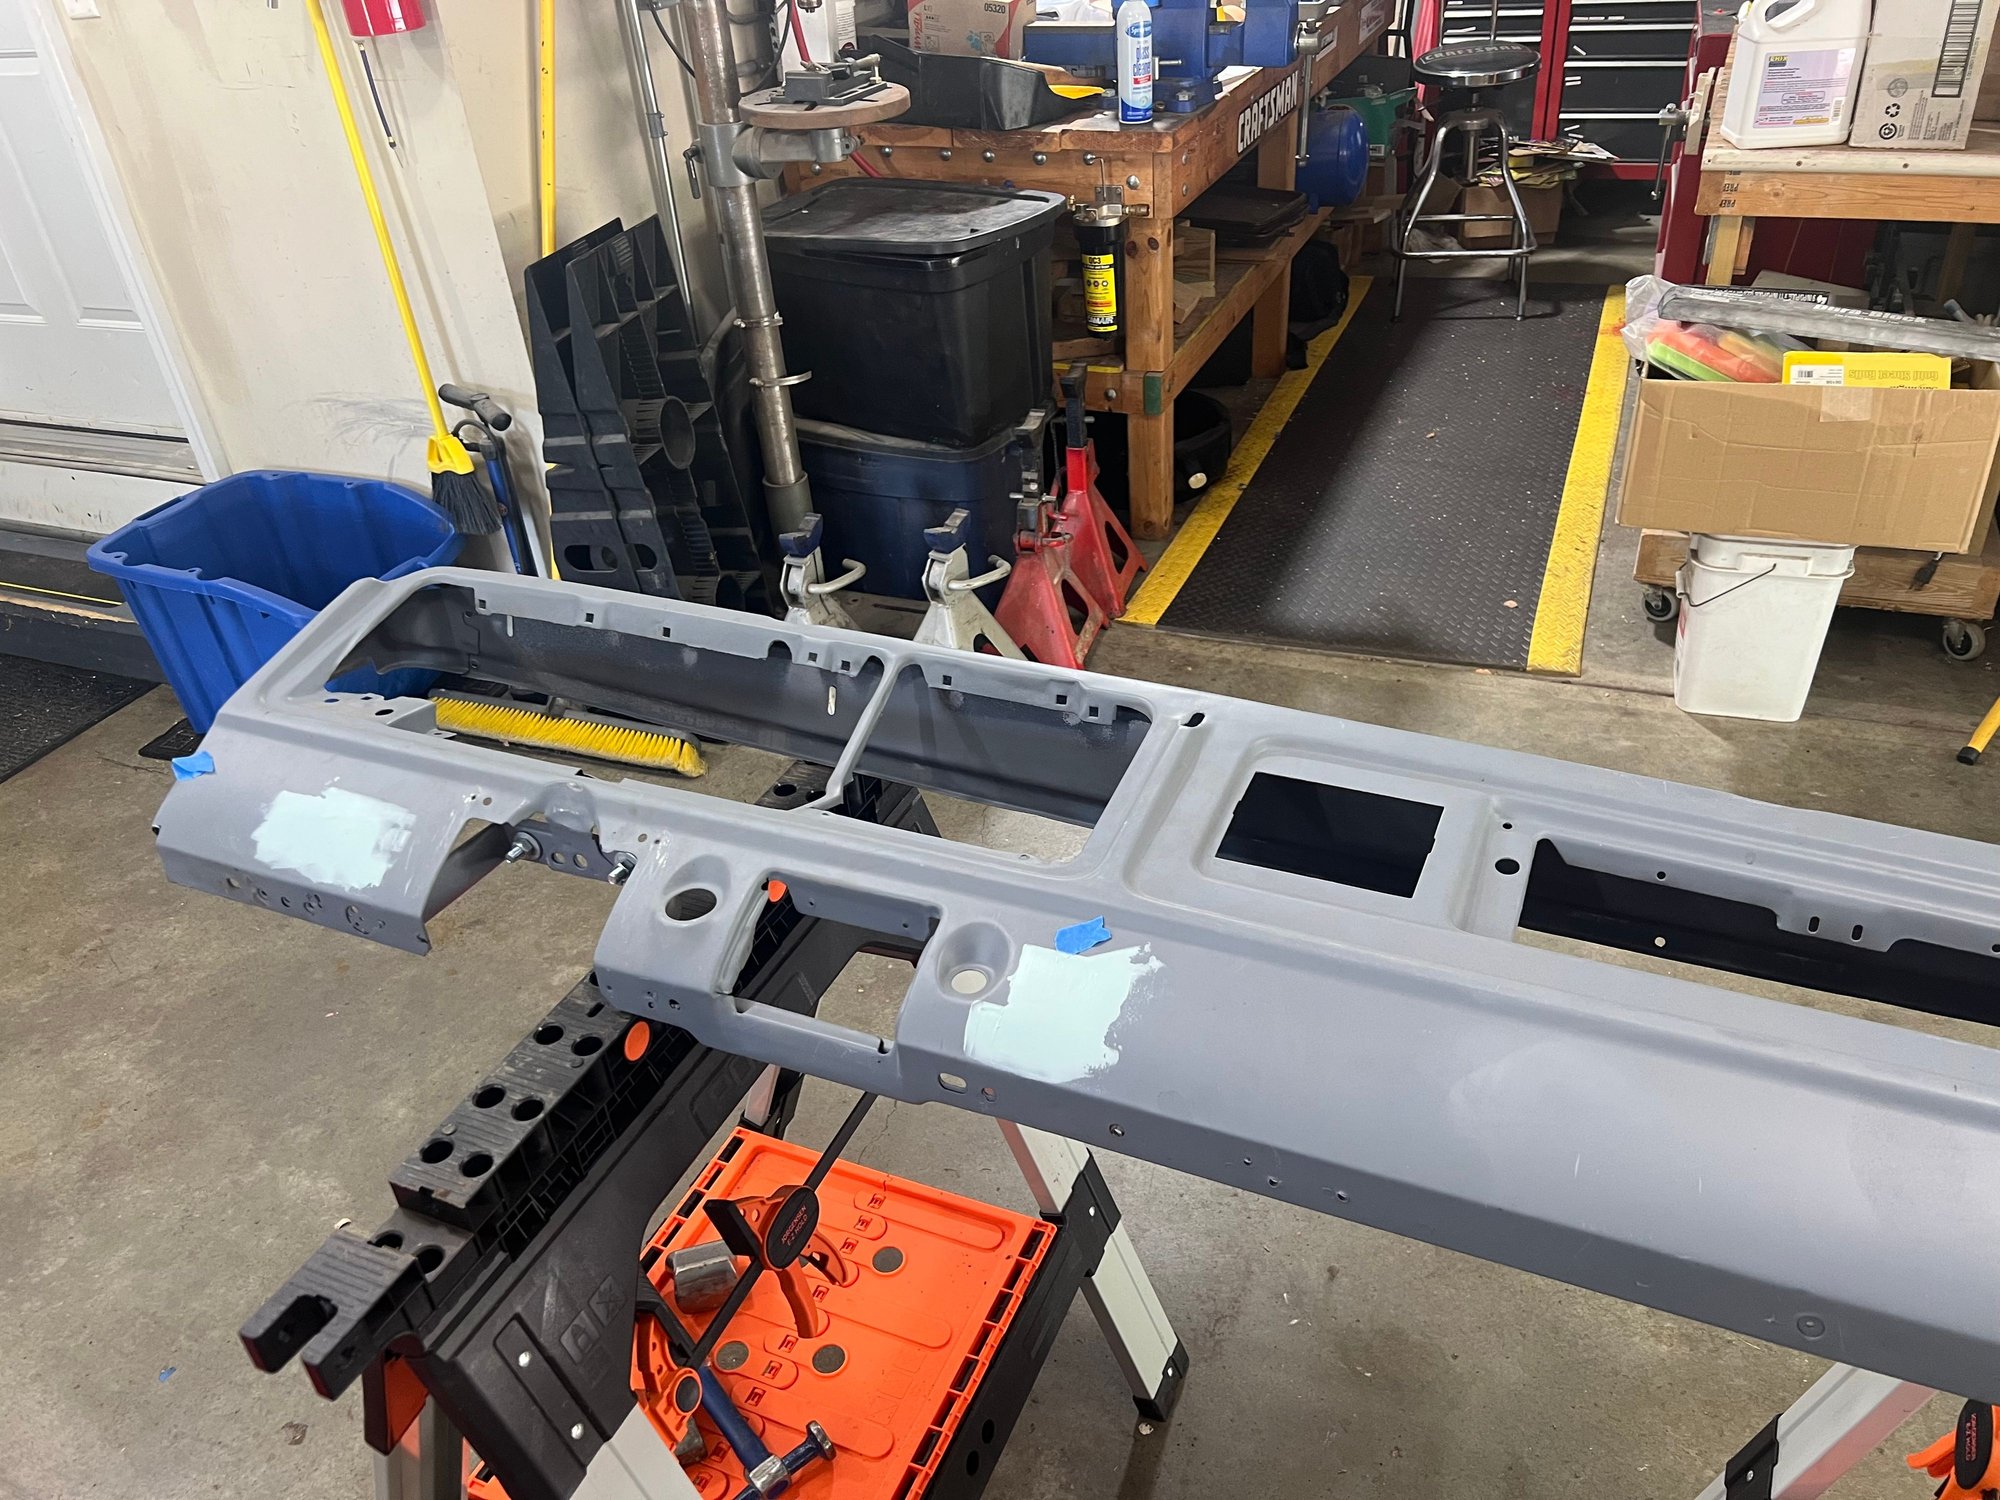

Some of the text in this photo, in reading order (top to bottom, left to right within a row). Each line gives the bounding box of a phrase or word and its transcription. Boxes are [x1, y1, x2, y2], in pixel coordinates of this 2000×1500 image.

[984, 2, 1006, 14] 05320
[1425, 45, 1522, 61] CRAFTSMAN
[1237, 70, 1299, 153] CRAFTSMAN
[1812, 303, 1928, 324] Dura-Block
[781, 1204, 807, 1244] JORGENSEN
